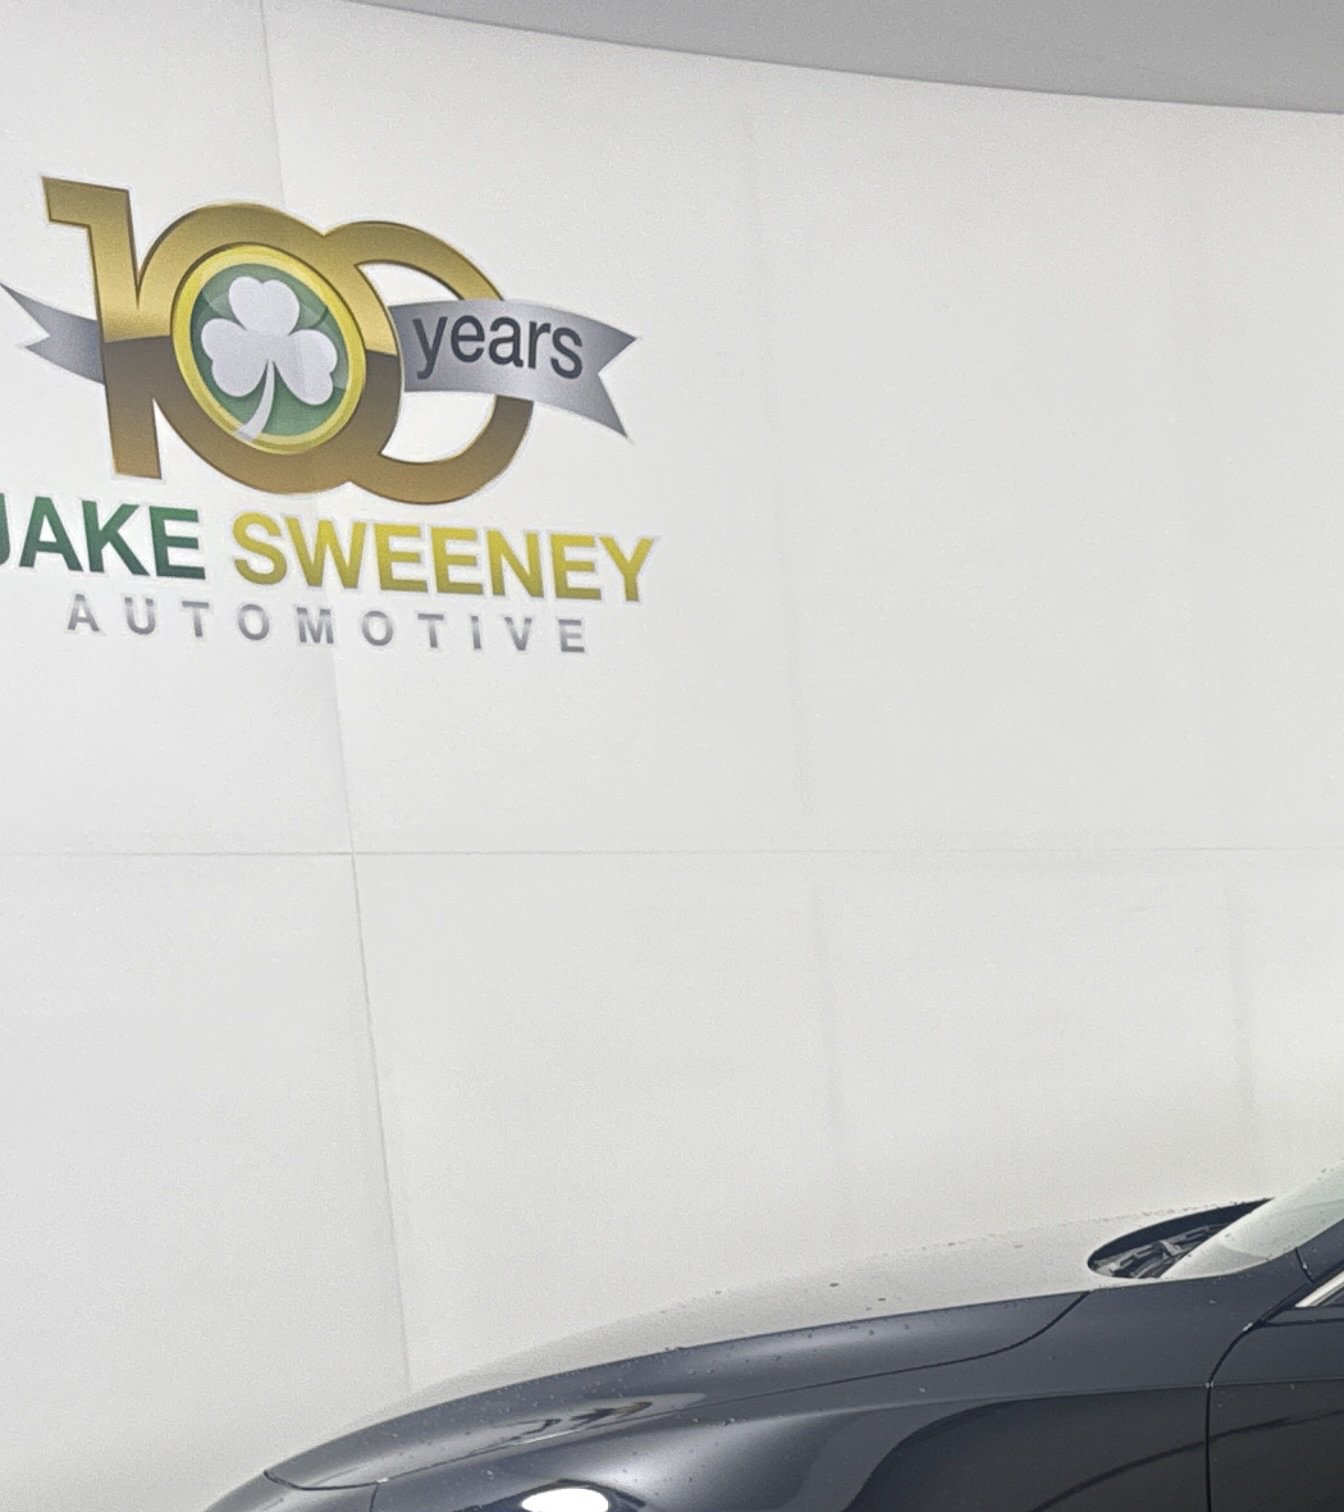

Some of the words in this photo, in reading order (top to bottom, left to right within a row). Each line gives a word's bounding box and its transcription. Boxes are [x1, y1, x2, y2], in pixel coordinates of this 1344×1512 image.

[42, 176, 535, 505] 100
[413, 314, 584, 380] years
[232, 512, 656, 602] SWEENEY
[67, 594, 587, 654] AUTOMOTIVE
